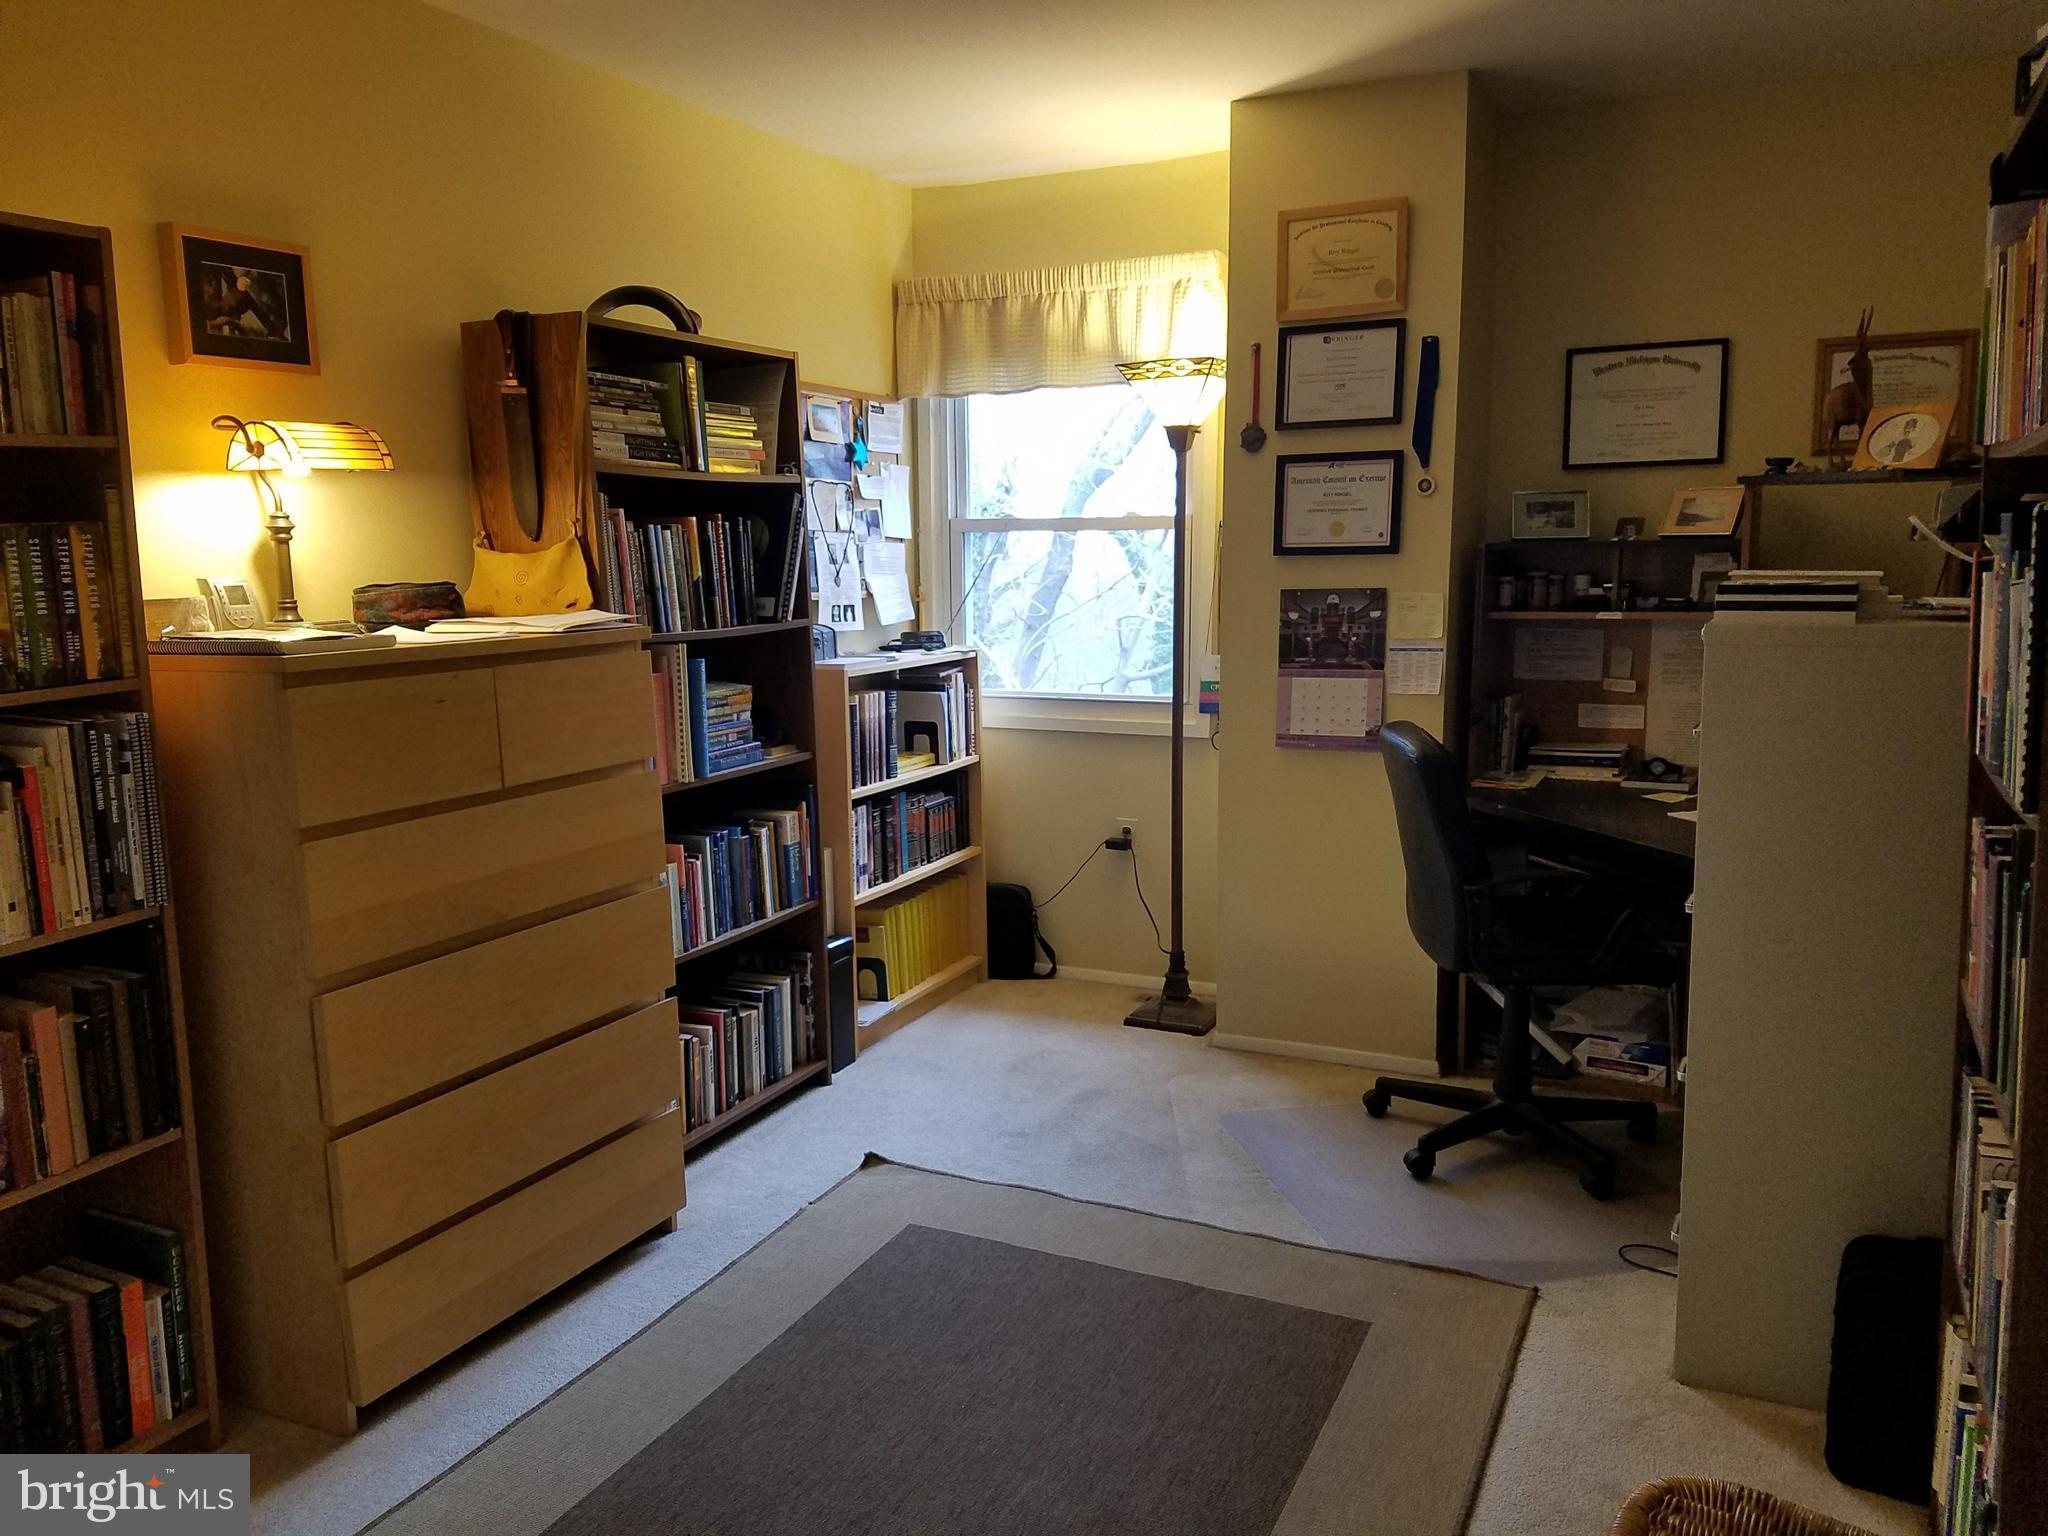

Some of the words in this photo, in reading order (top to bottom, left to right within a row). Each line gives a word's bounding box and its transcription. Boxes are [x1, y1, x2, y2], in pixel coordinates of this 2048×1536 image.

[28, 538, 44, 584] STEPHEN
[56, 538, 72, 584] STEPHEN
[81, 534, 96, 578] STEPHEN
[34, 590, 48, 615] KING
[62, 590, 76, 615] KING
[88, 585, 100, 609] KING
[88, 730, 100, 775] KETTLEBELL
[94, 776, 105, 811] TRAINING
[105, 746, 114, 775] Personal
[108, 776, 117, 798] Trainer
[111, 799, 120, 824] Manual
